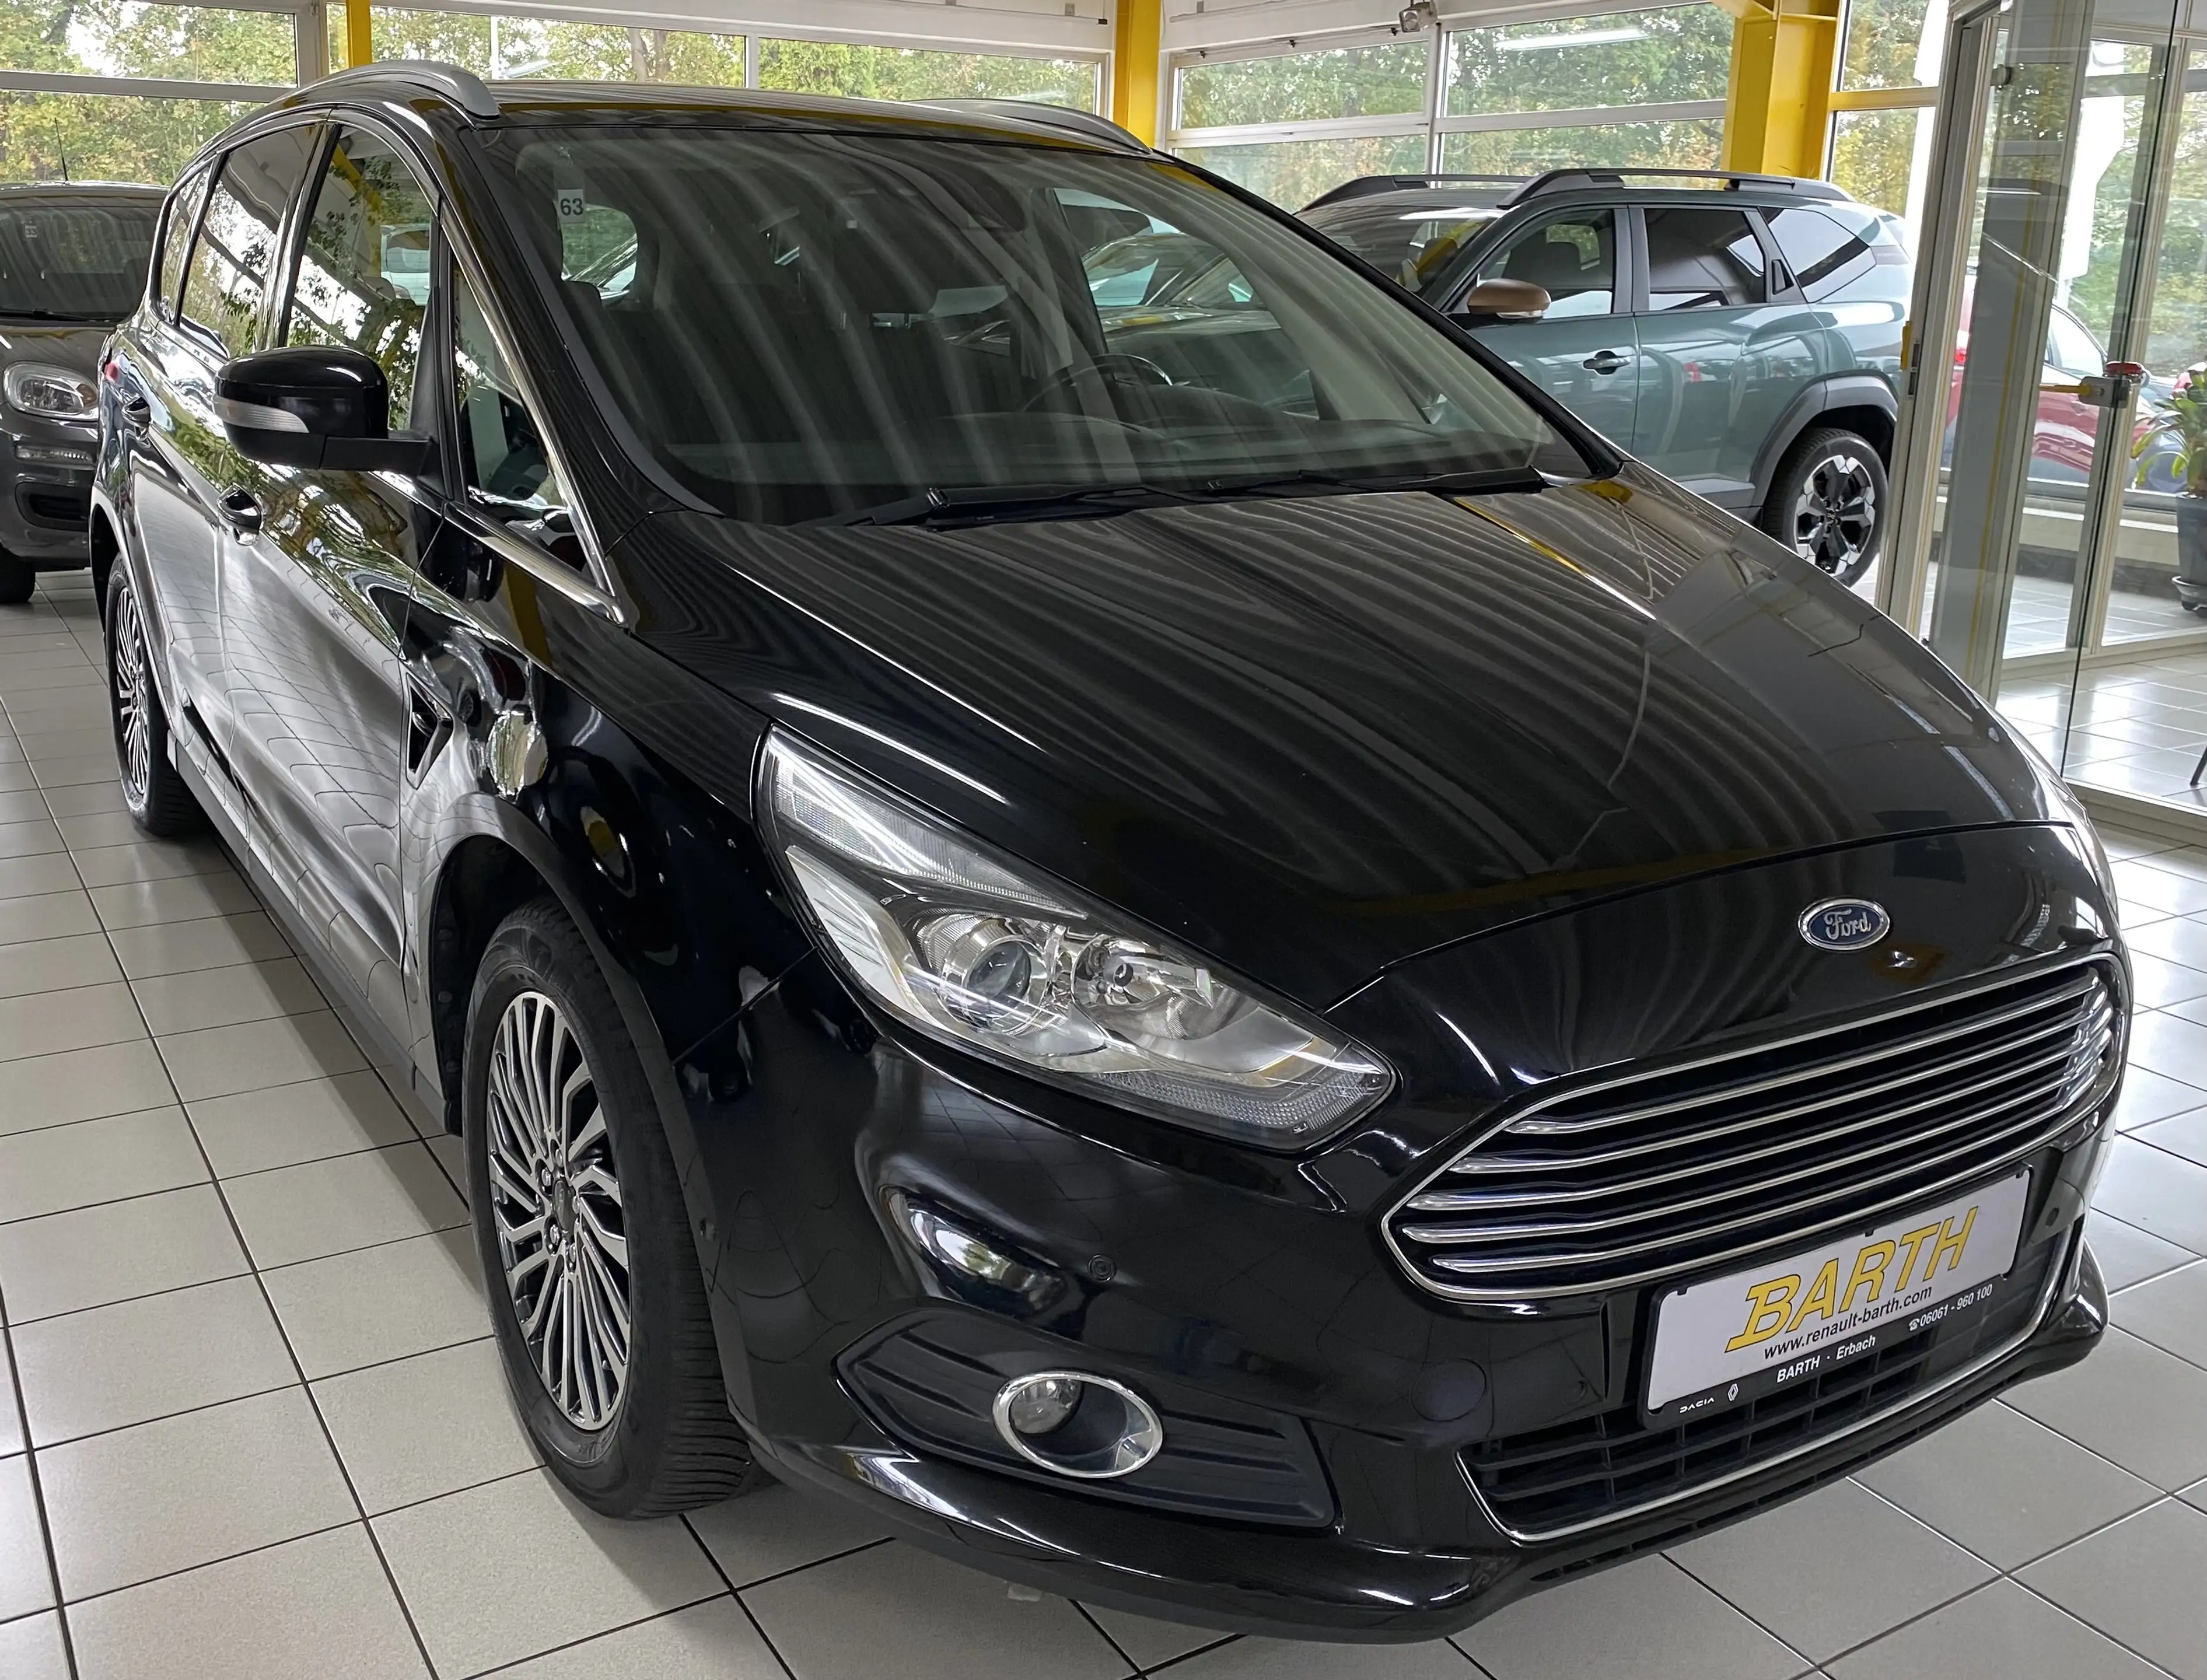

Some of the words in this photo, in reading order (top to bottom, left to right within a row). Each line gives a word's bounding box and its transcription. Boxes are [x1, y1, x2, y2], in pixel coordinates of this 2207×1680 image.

[560, 198, 583, 216] 63
[1823, 908, 1872, 940] Ford
[1725, 1206, 1978, 1353] BARTH
[1764, 1286, 1932, 1359] www.renault-barth.com
[1919, 1304, 1949, 1327] 06061
[1956, 1293, 1974, 1311] 960
[1976, 1284, 1993, 1301] 100
[1776, 1355, 1821, 1383] BARTH
[1836, 1335, 1876, 1360] Erbach
[1680, 1397, 1715, 1413] DACIA
